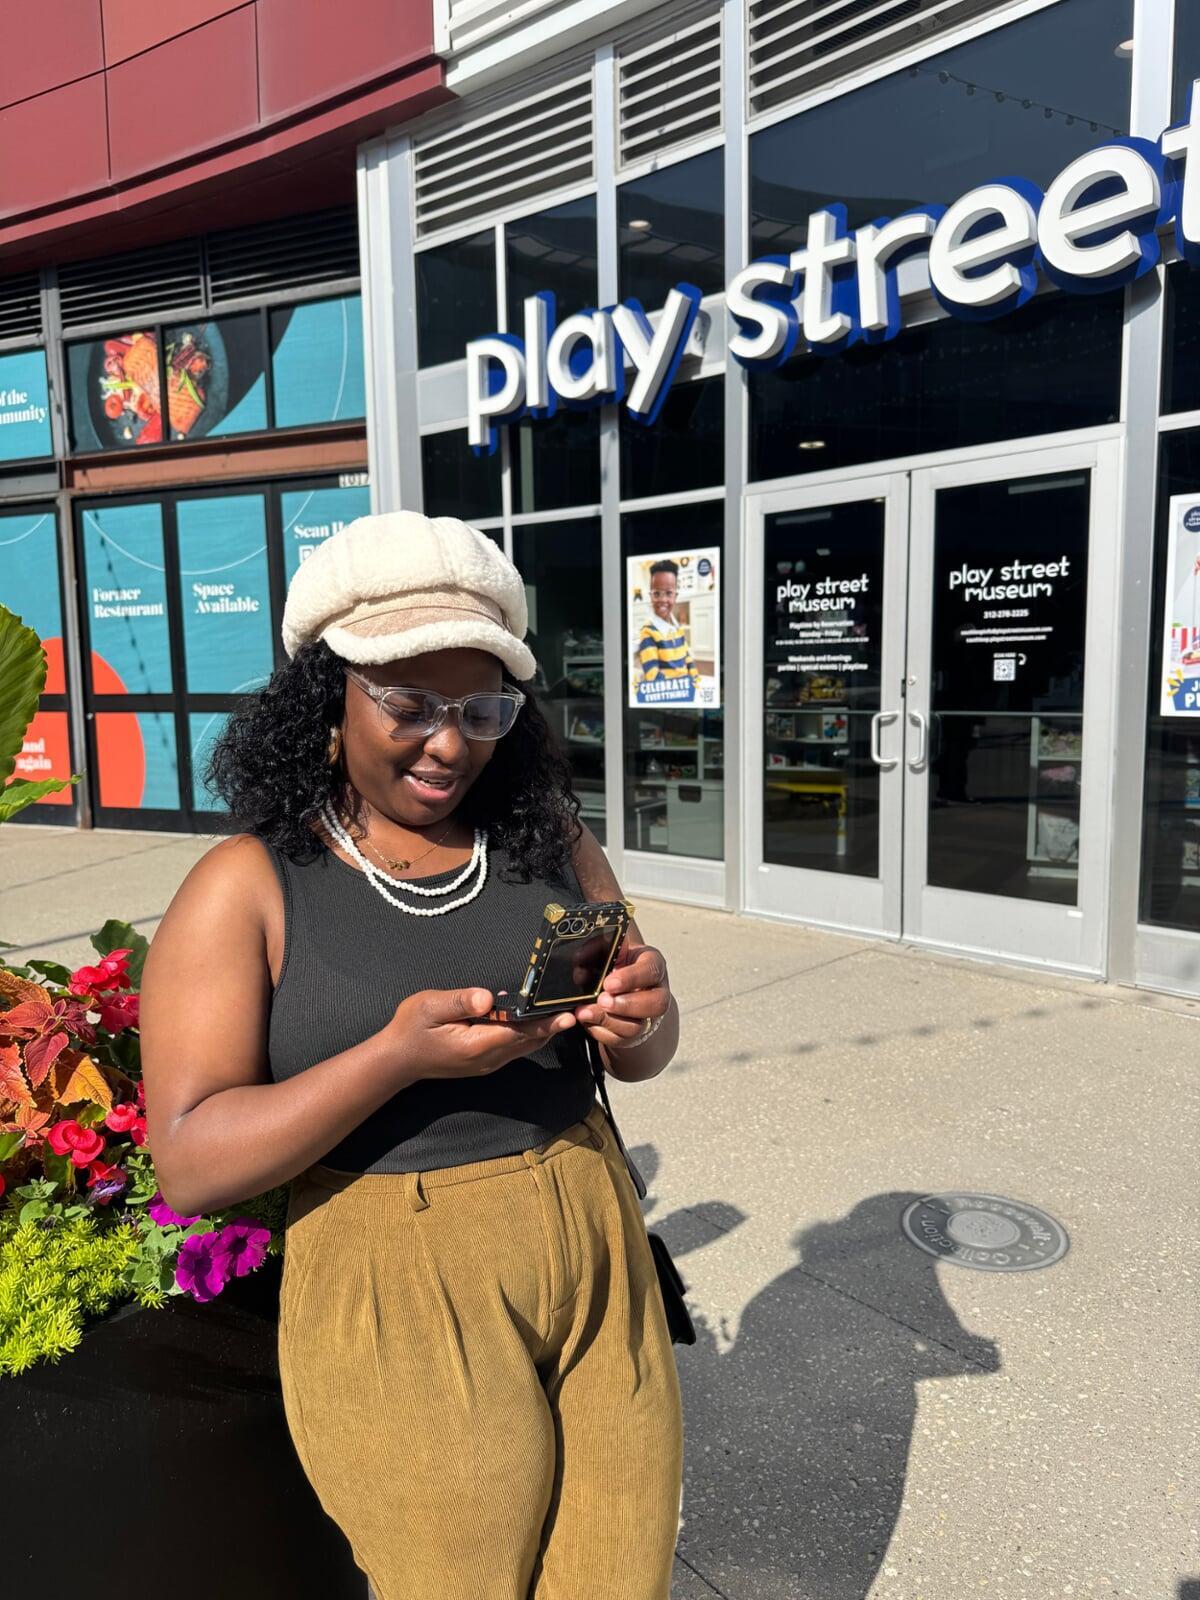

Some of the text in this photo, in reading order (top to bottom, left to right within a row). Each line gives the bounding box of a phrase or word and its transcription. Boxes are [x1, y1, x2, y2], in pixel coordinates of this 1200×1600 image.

[467, 286, 698, 453] play
[7, 388, 28, 406] the
[293, 523, 330, 540] Scan
[949, 555, 1072, 591] play street
[93, 587, 142, 603] Former
[192, 582, 235, 601] Space
[776, 573, 870, 603] play street
[964, 582, 1053, 602] museum
[94, 602, 164, 618] Restaurant
[195, 596, 260, 614] Available
[788, 596, 856, 614] museum
[640, 677, 690, 695] CELEBRATE
[16, 752, 52, 773] again
